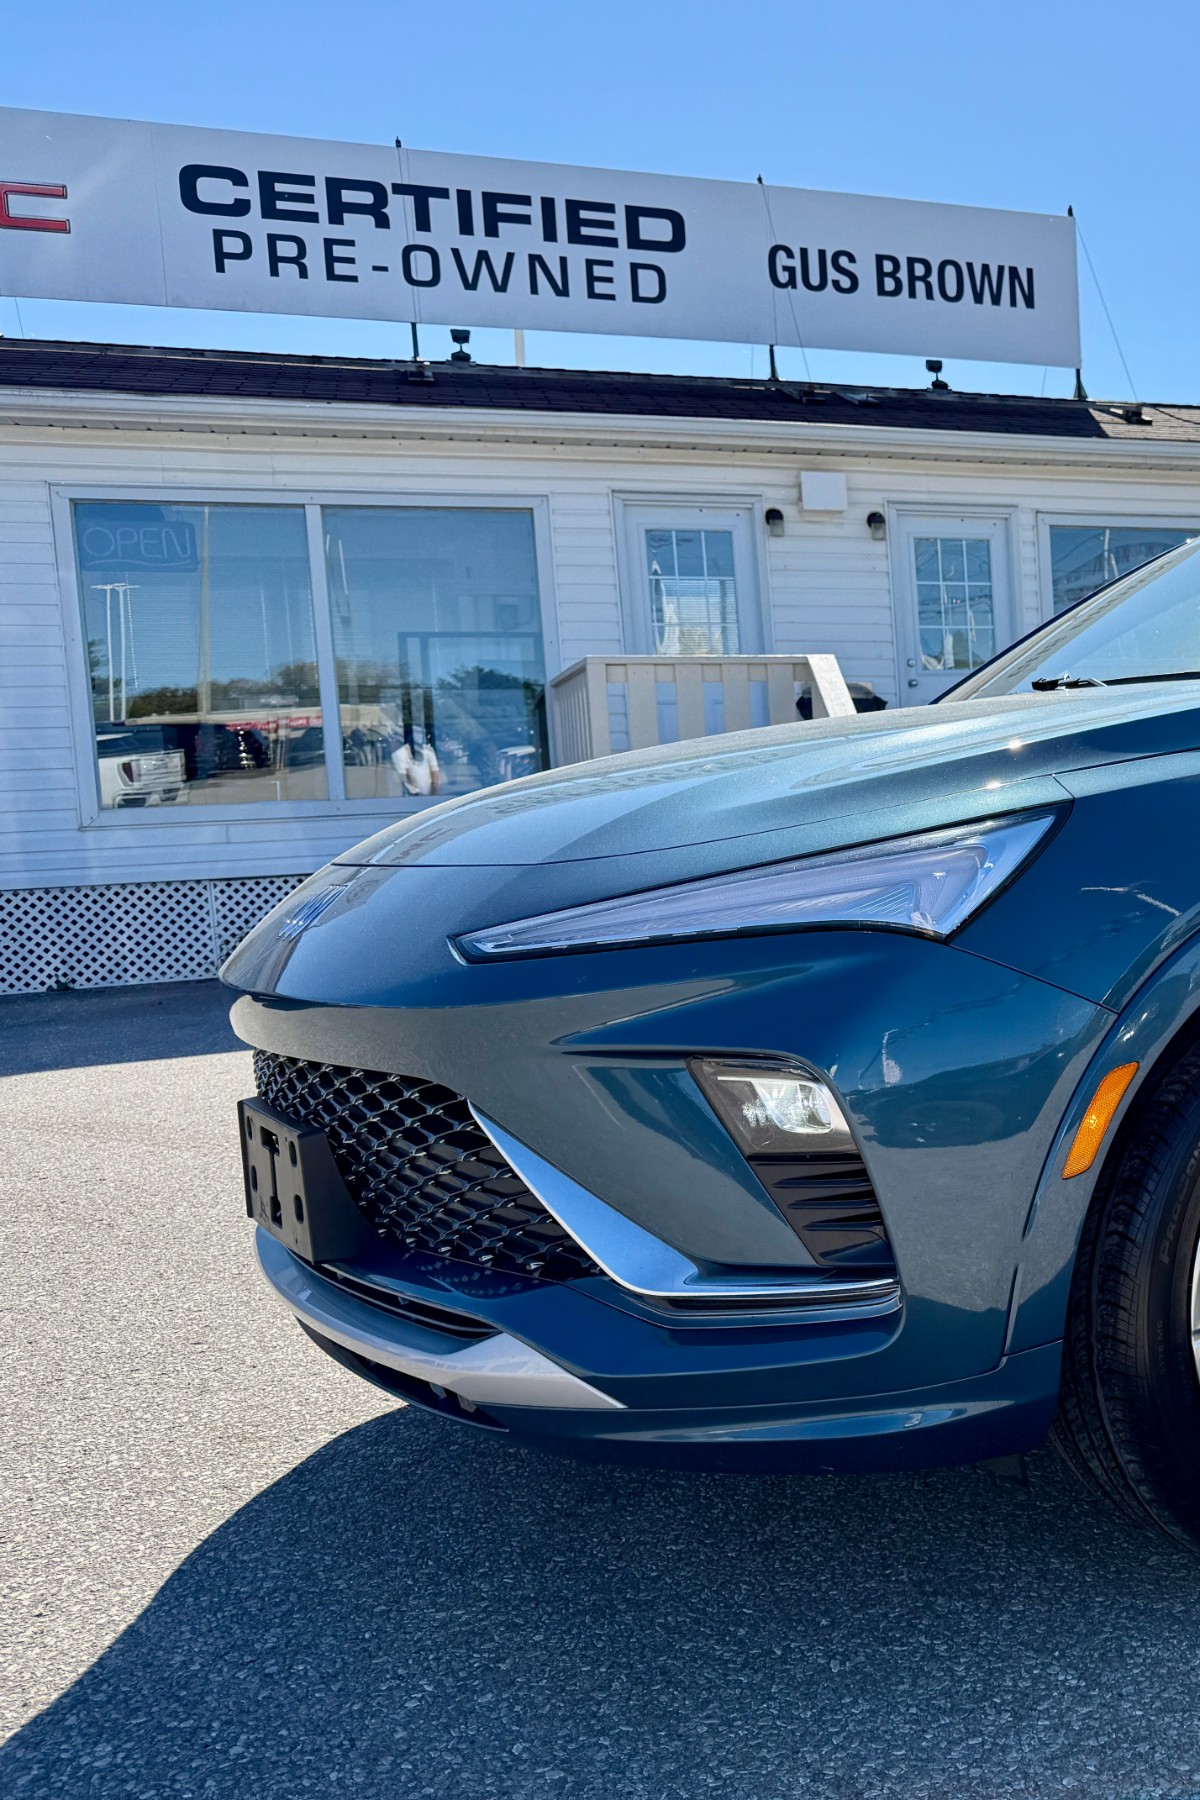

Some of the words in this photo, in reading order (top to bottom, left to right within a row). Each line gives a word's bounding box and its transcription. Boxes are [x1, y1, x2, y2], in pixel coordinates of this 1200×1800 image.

[179, 164, 686, 252] CERTIFIED
[212, 229, 667, 304] PRE-OWNED
[768, 244, 859, 295] GUS
[875, 253, 1035, 309] BROWN
[83, 527, 191, 558] OPEN
